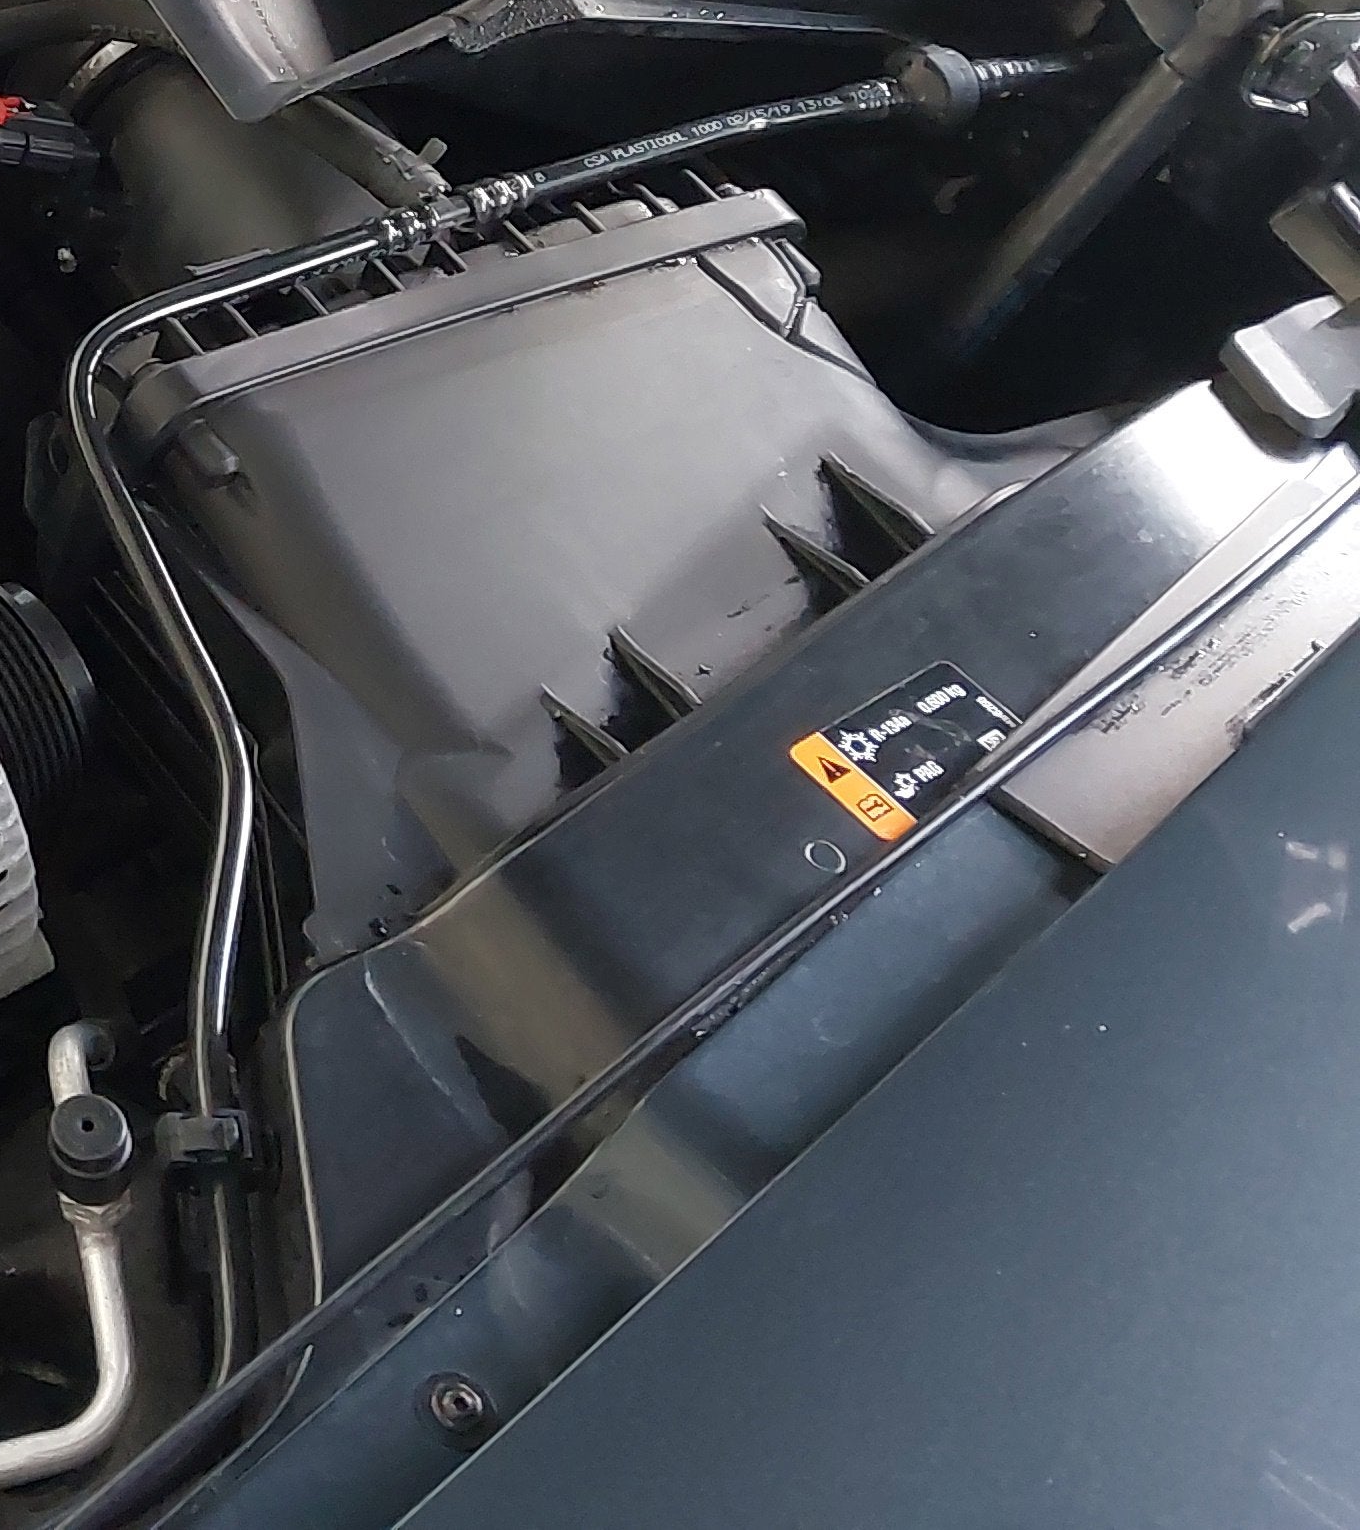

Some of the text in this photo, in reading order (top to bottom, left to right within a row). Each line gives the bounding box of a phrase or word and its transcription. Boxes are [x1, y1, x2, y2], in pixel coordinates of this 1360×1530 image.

[583, 153, 610, 168] CSA
[612, 131, 688, 160] PLASTICOOL
[691, 120, 723, 136] 1000
[727, 106, 791, 126] 02/15/19
[942, 683, 968, 699] kg
[912, 760, 945, 783] PAG
